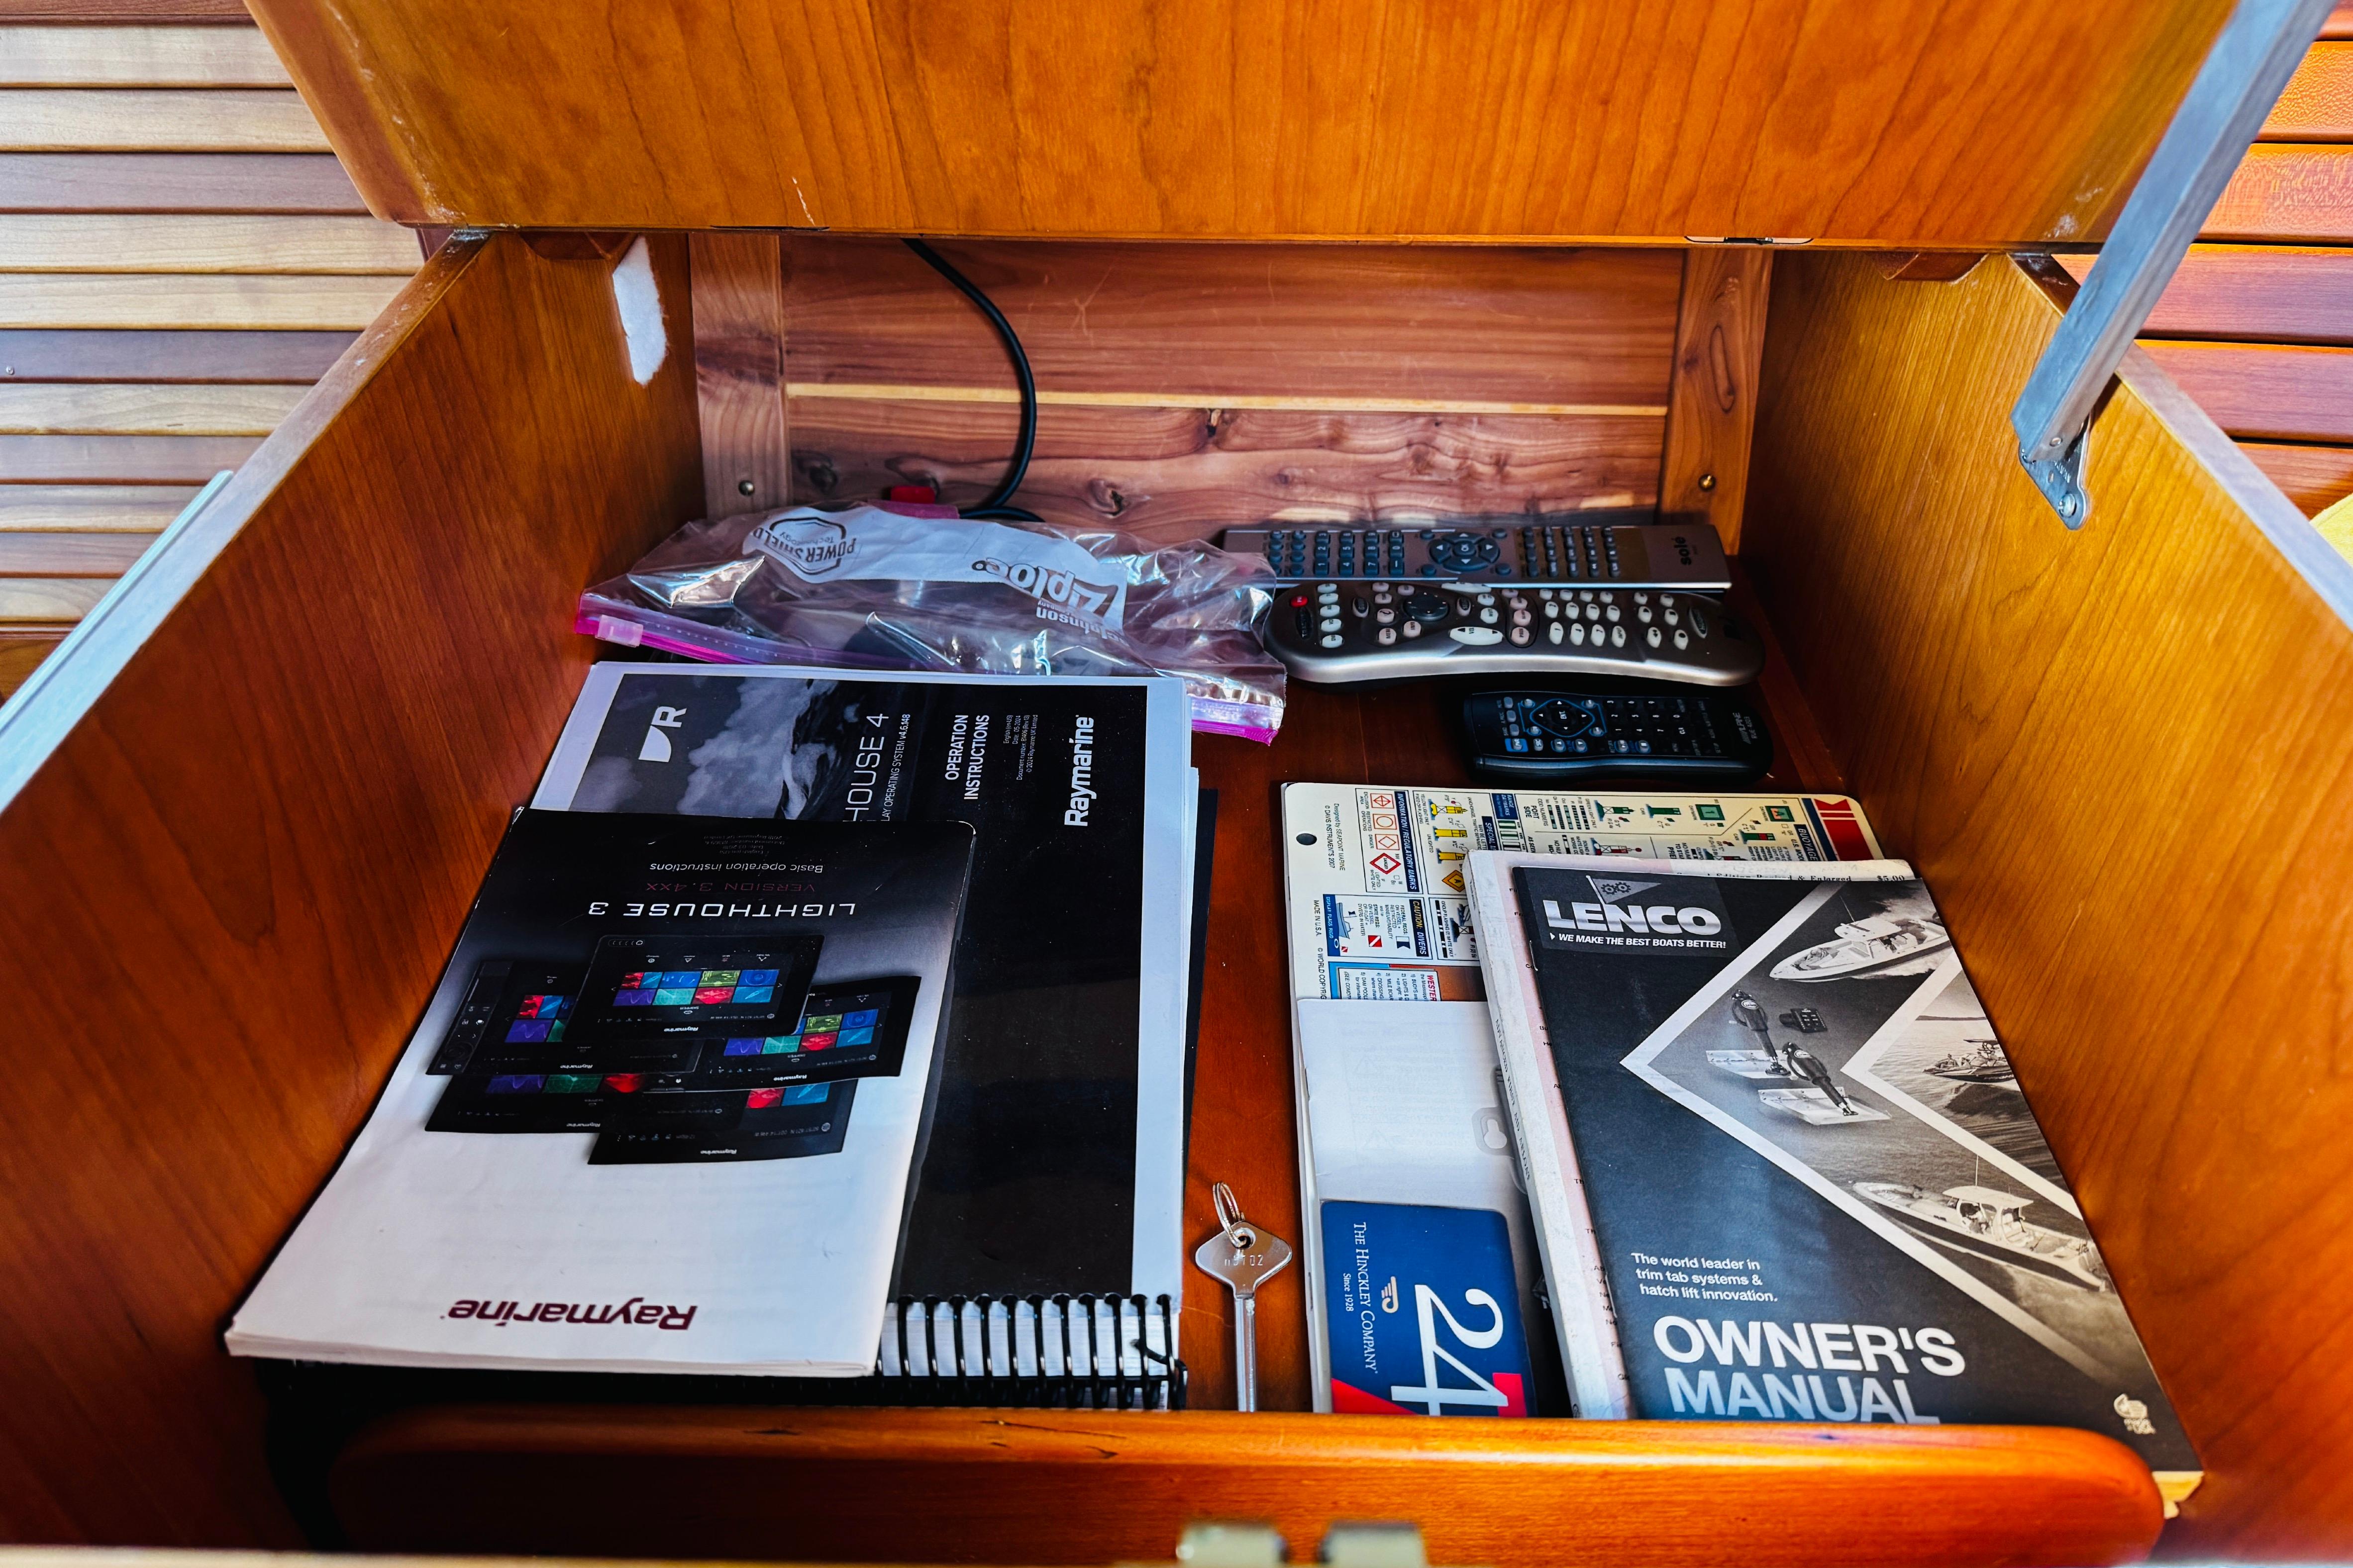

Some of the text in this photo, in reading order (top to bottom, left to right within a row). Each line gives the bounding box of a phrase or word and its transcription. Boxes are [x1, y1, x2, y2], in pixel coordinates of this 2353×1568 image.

[806, 538, 856, 563] POWER
[866, 712, 890, 728] 4
[945, 714, 969, 781] OPERATION
[964, 714, 990, 800] INSTRUCTIONS
[1027, 736, 1036, 756] Raymarine
[884, 768, 900, 806] OPERATING
[892, 740, 906, 766] SYSTEM
[900, 713, 911, 740] v4.6.148
[1016, 760, 1024, 780] Document
[1064, 715, 1097, 826] Raymarine
[1524, 806, 1532, 818] SIDE
[1531, 805, 1539, 819] PORT
[1540, 807, 1548, 826] NUMBERS
[1326, 823, 1334, 857] INSTRUMENTS
[1485, 822, 1494, 844] SPECIAL
[649, 863, 823, 873] Basic operation instructions
[725, 883, 816, 892] VERSION
[1408, 869, 1416, 890] MARKS
[589, 902, 855, 917] LIGHTHOUSE 3
[1543, 900, 1721, 935] LENCO
[1413, 900, 1427, 955] CAUTION: DIVERS
[1559, 933, 1727, 949] WE MAKE THE BEST BOATS BETTER!
[1631, 1253, 1760, 1270] The world leader in
[1636, 1268, 1763, 1286] trim tab systems &
[1343, 1273, 1354, 1312] Since 1928
[1353, 1222, 1377, 1371] THE HINCKLEY COMPANY
[1639, 1283, 1778, 1302] hatch lift innovation.
[448, 1297, 698, 1331] Raymarine
[1391, 1284, 1509, 1416] 24
[1652, 1315, 1967, 1376] OWNER'S
[1663, 1366, 1941, 1424] MANUAL
